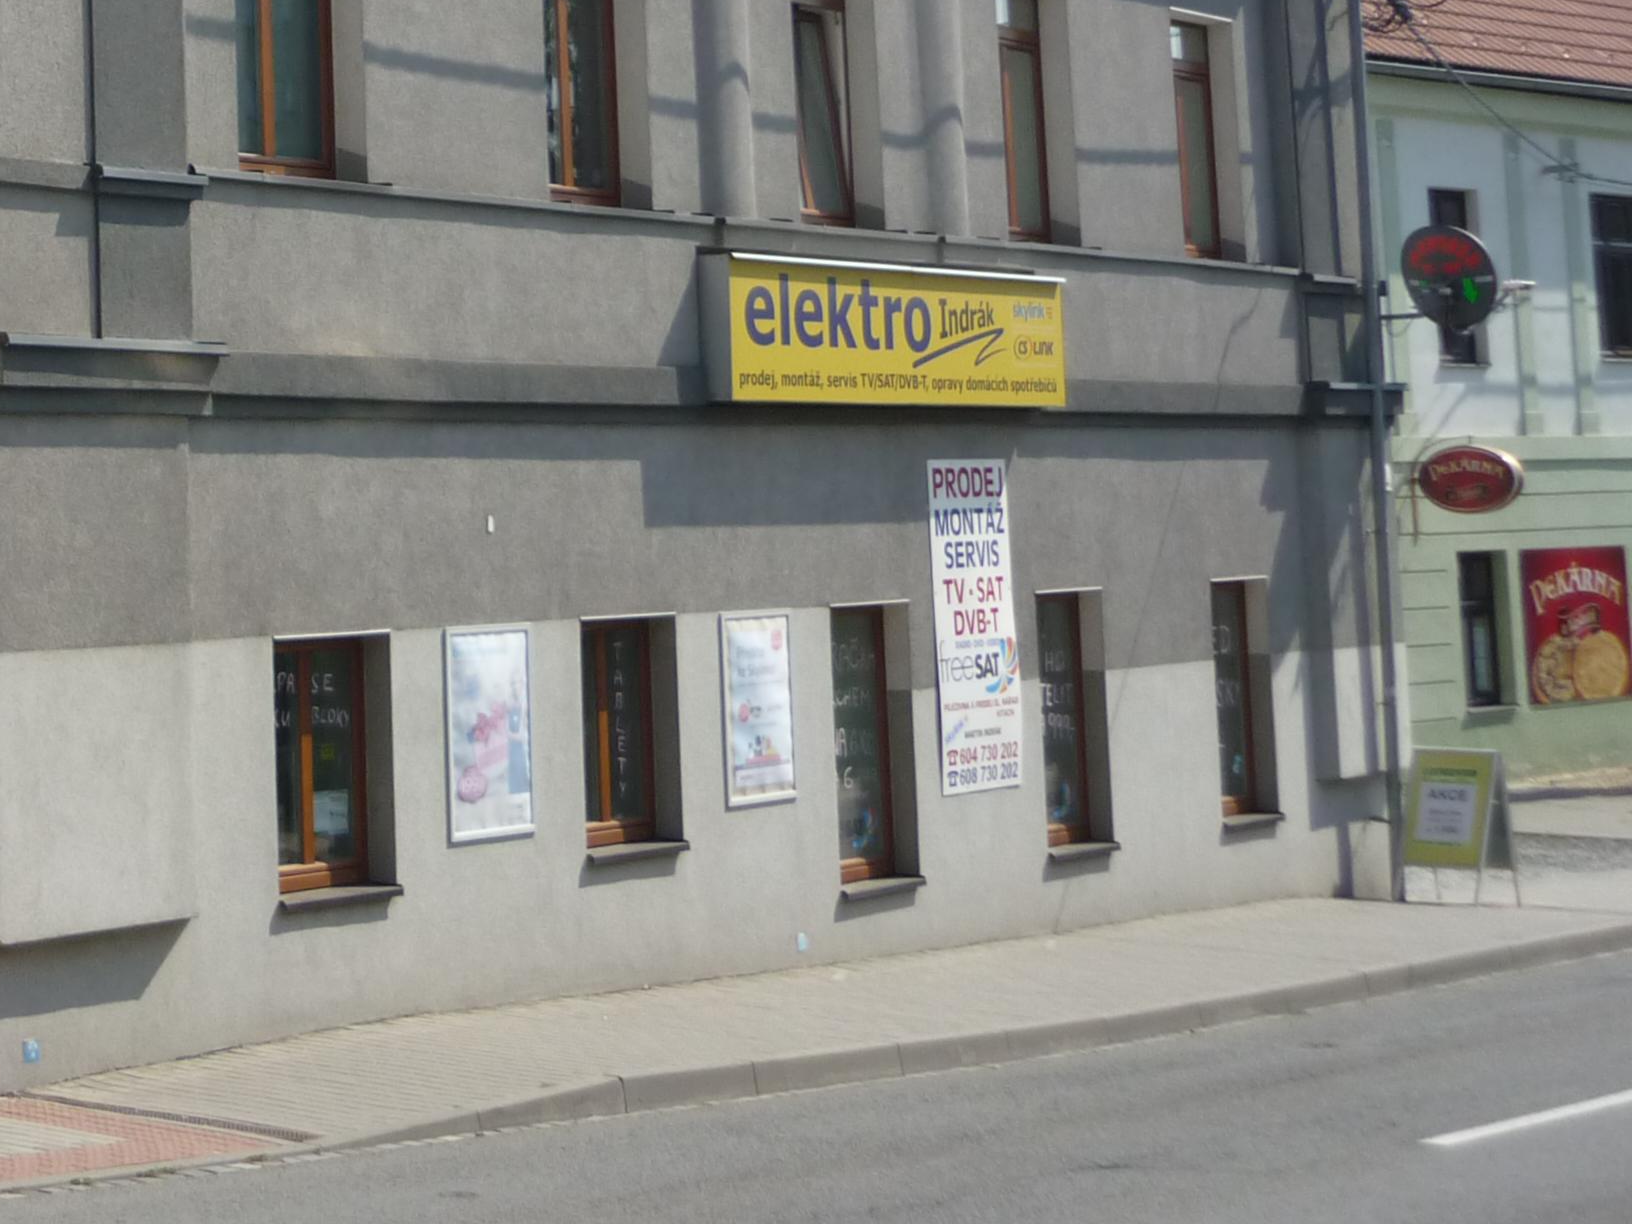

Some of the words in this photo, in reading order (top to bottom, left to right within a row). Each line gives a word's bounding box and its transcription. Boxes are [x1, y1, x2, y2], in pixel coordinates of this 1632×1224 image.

[744, 273, 931, 353] elektro
[938, 298, 994, 339] Indrák
[739, 370, 778, 390] prodej,
[781, 370, 823, 390] montáž,
[827, 372, 857, 389] servis
[931, 377, 963, 394] opravy
[966, 376, 1008, 392] domácích
[932, 466, 1004, 499] PRODEJ
[934, 502, 1005, 536] MONTÁŽ
[944, 539, 999, 569] SERVIS
[943, 578, 965, 604] TV
[976, 576, 1003, 603] SAT
[953, 607, 999, 636] DVB-T
[960, 747, 978, 765] 604
[980, 744, 998, 762] 730
[1000, 741, 1019, 759] 202
[980, 764, 998, 782] 730
[1000, 761, 1019, 779] 202
